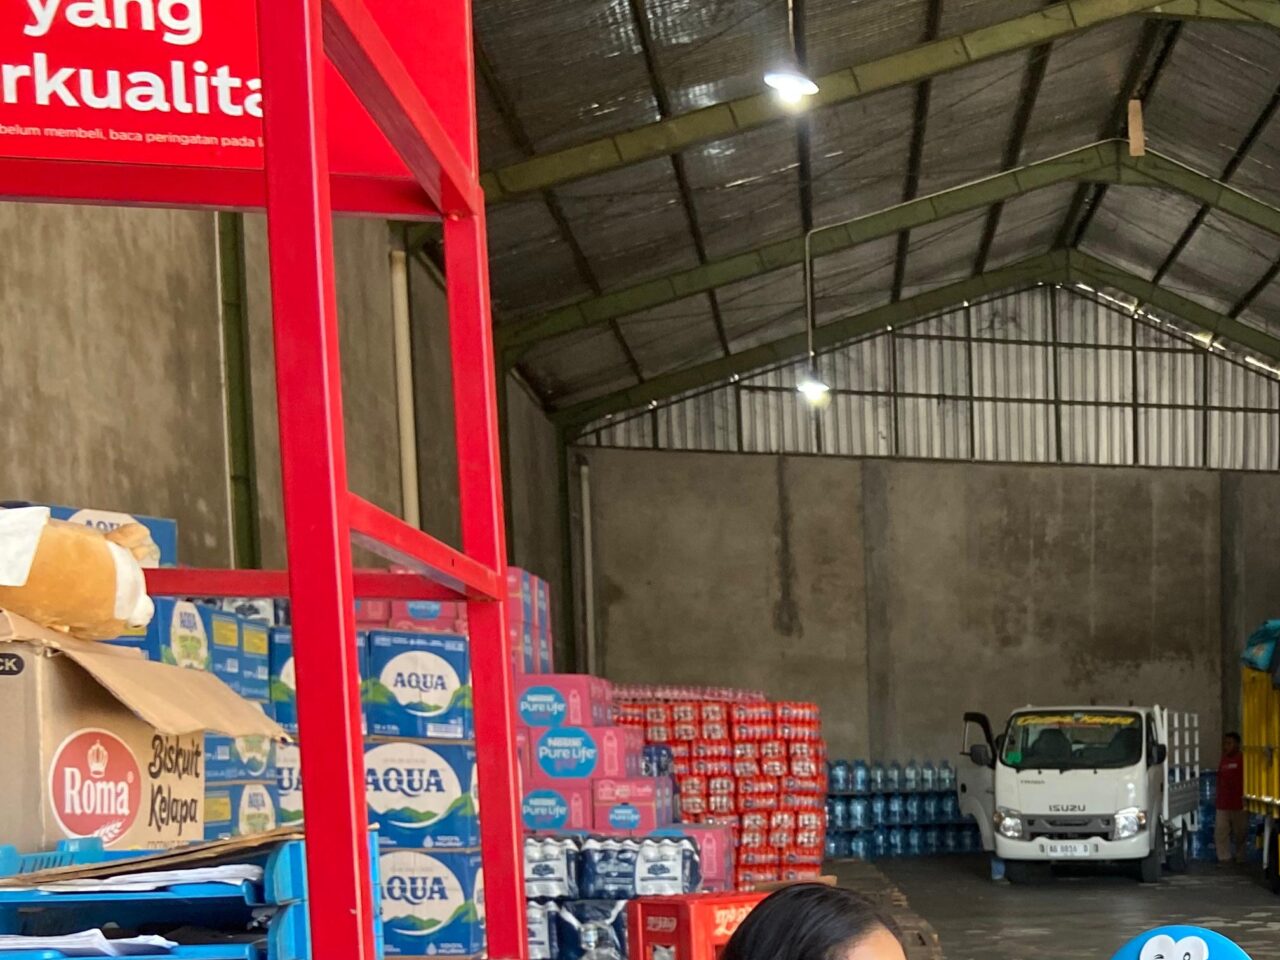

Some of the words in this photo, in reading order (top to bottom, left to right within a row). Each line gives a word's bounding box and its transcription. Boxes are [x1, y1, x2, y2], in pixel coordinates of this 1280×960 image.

[24, 0, 203, 44] yang
[109, 129, 143, 142] baca
[146, 133, 218, 146] peringatan
[221, 138, 256, 148] pada
[393, 672, 447, 693] AQUA
[148, 735, 201, 780] Biskuit
[539, 746, 570, 758] Pure
[572, 747, 597, 763] Life
[64, 767, 130, 816] Roma
[366, 768, 445, 797] AQUA
[148, 784, 198, 837] Kelapa
[381, 876, 448, 905] QUA
